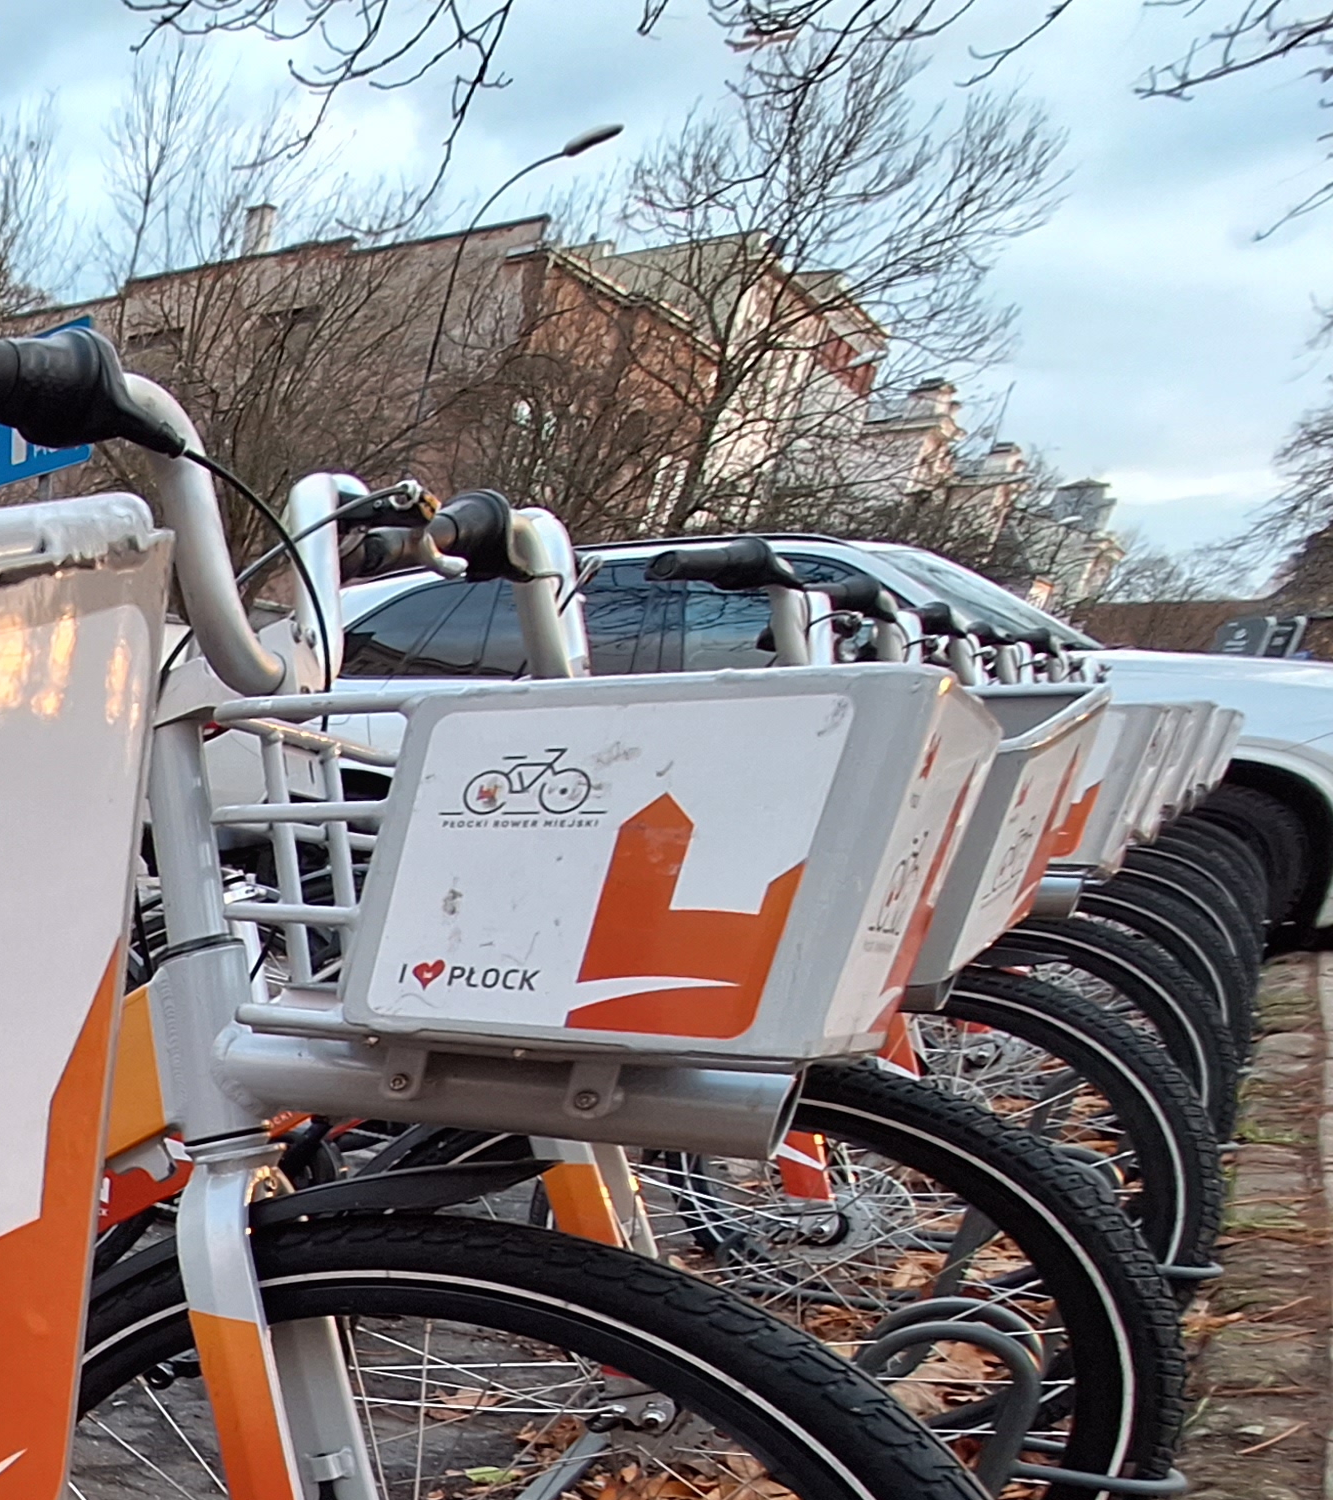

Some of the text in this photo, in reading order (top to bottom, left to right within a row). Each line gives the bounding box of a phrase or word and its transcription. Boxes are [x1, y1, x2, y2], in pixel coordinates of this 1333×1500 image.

[442, 818, 599, 829] PŁOCKI ROWER MIEJSKI
[398, 963, 541, 991] I PŁOCK
